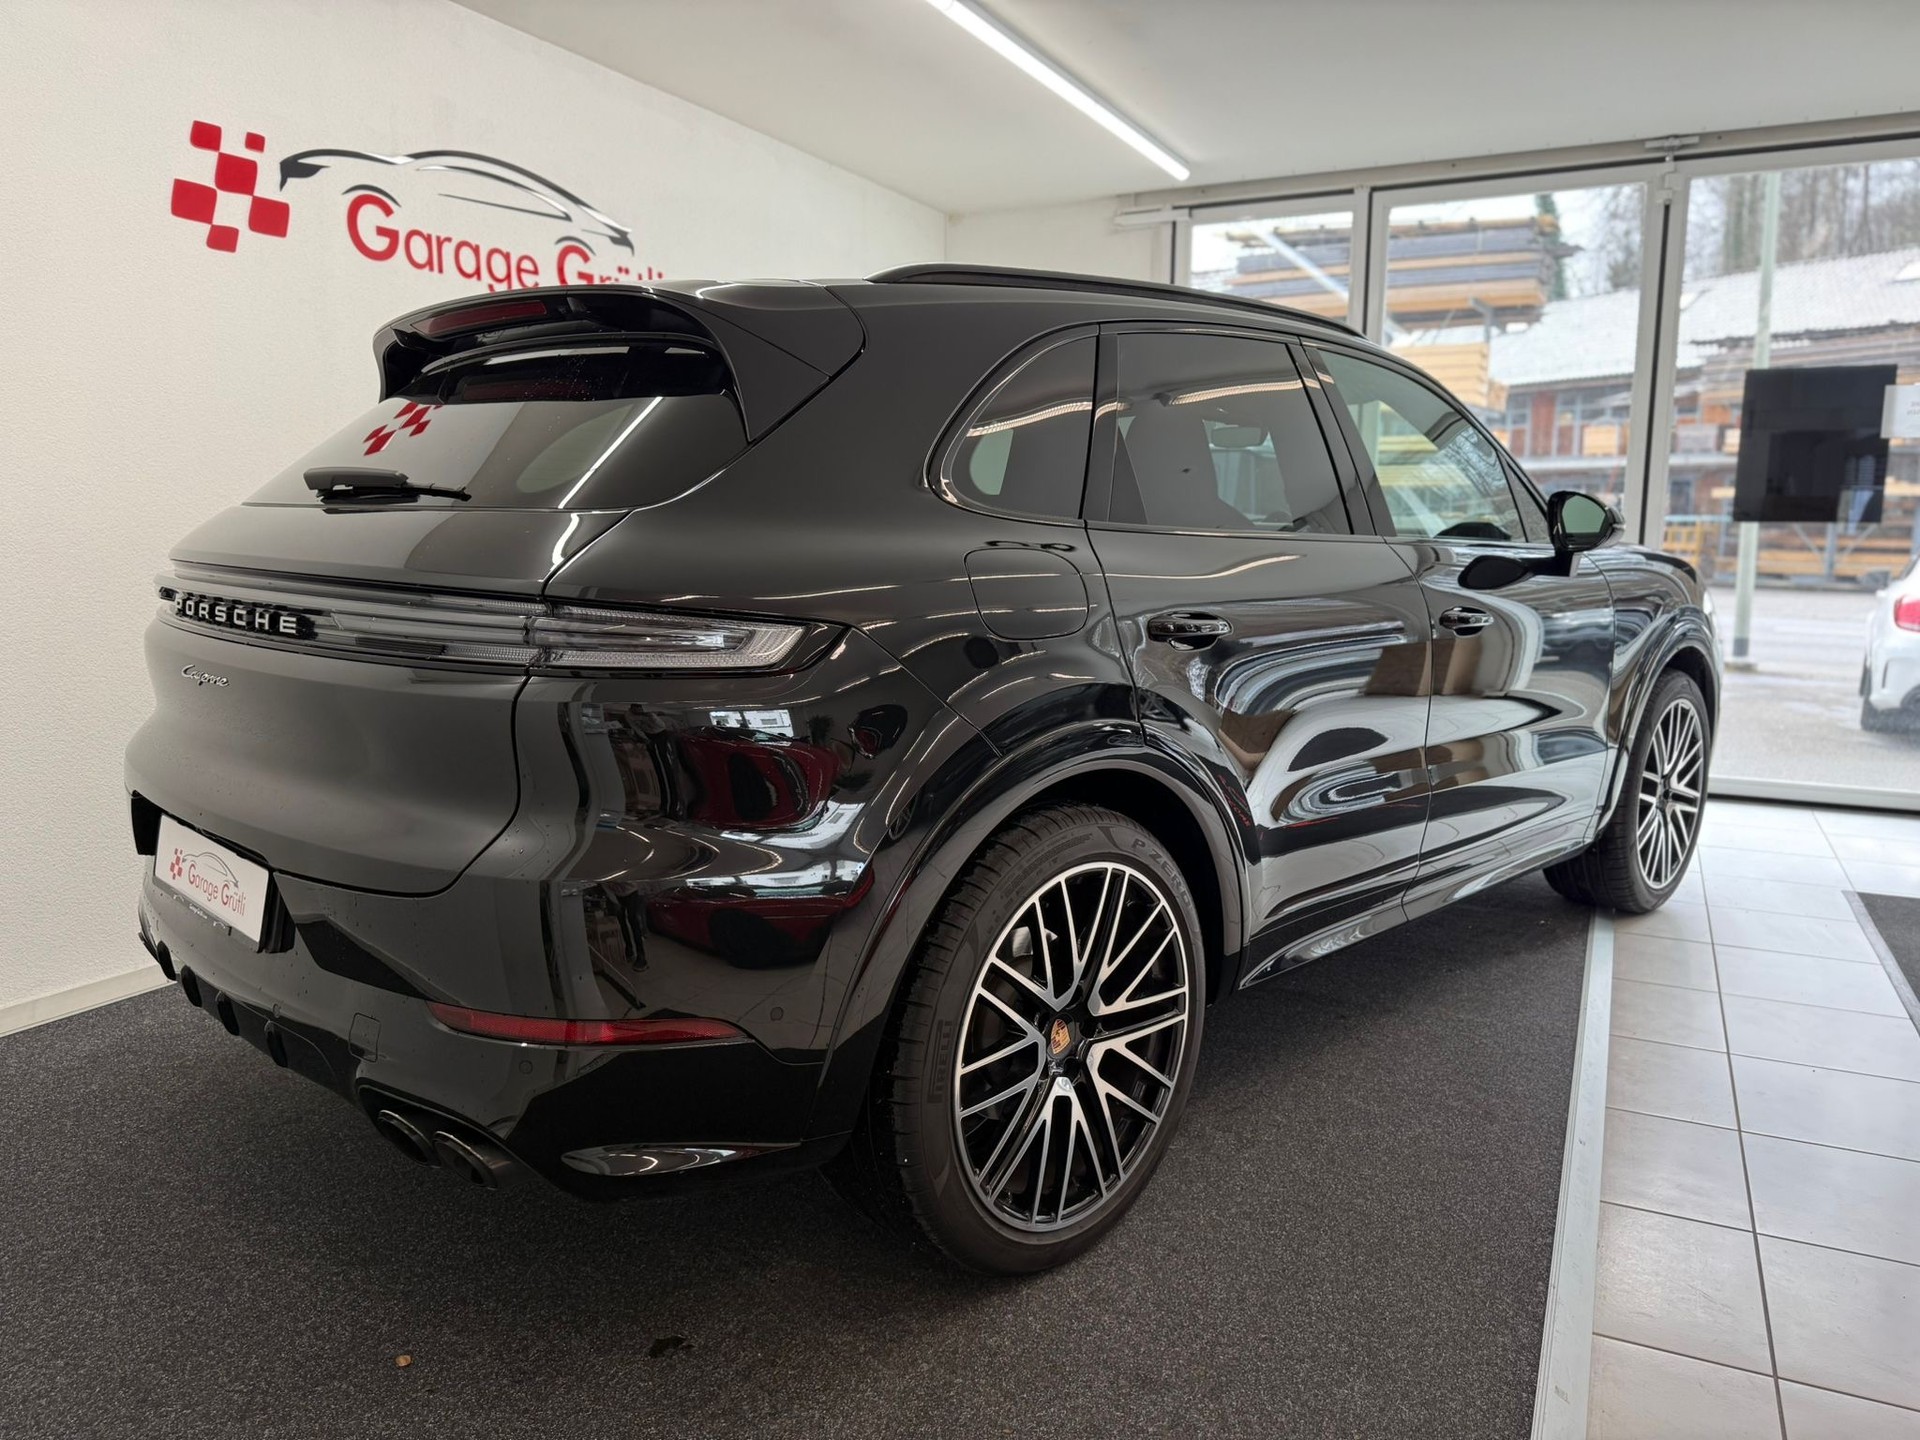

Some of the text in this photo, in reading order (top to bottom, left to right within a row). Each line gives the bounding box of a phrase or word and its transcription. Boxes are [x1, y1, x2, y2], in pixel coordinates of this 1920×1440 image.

[346, 193, 540, 293] Garage
[174, 595, 297, 633] PORSCHE
[181, 664, 230, 687] Cayenne
[188, 863, 219, 902] Garage
[221, 883, 247, 916] Grütli
[926, 1019, 953, 1104] PIRELLI
